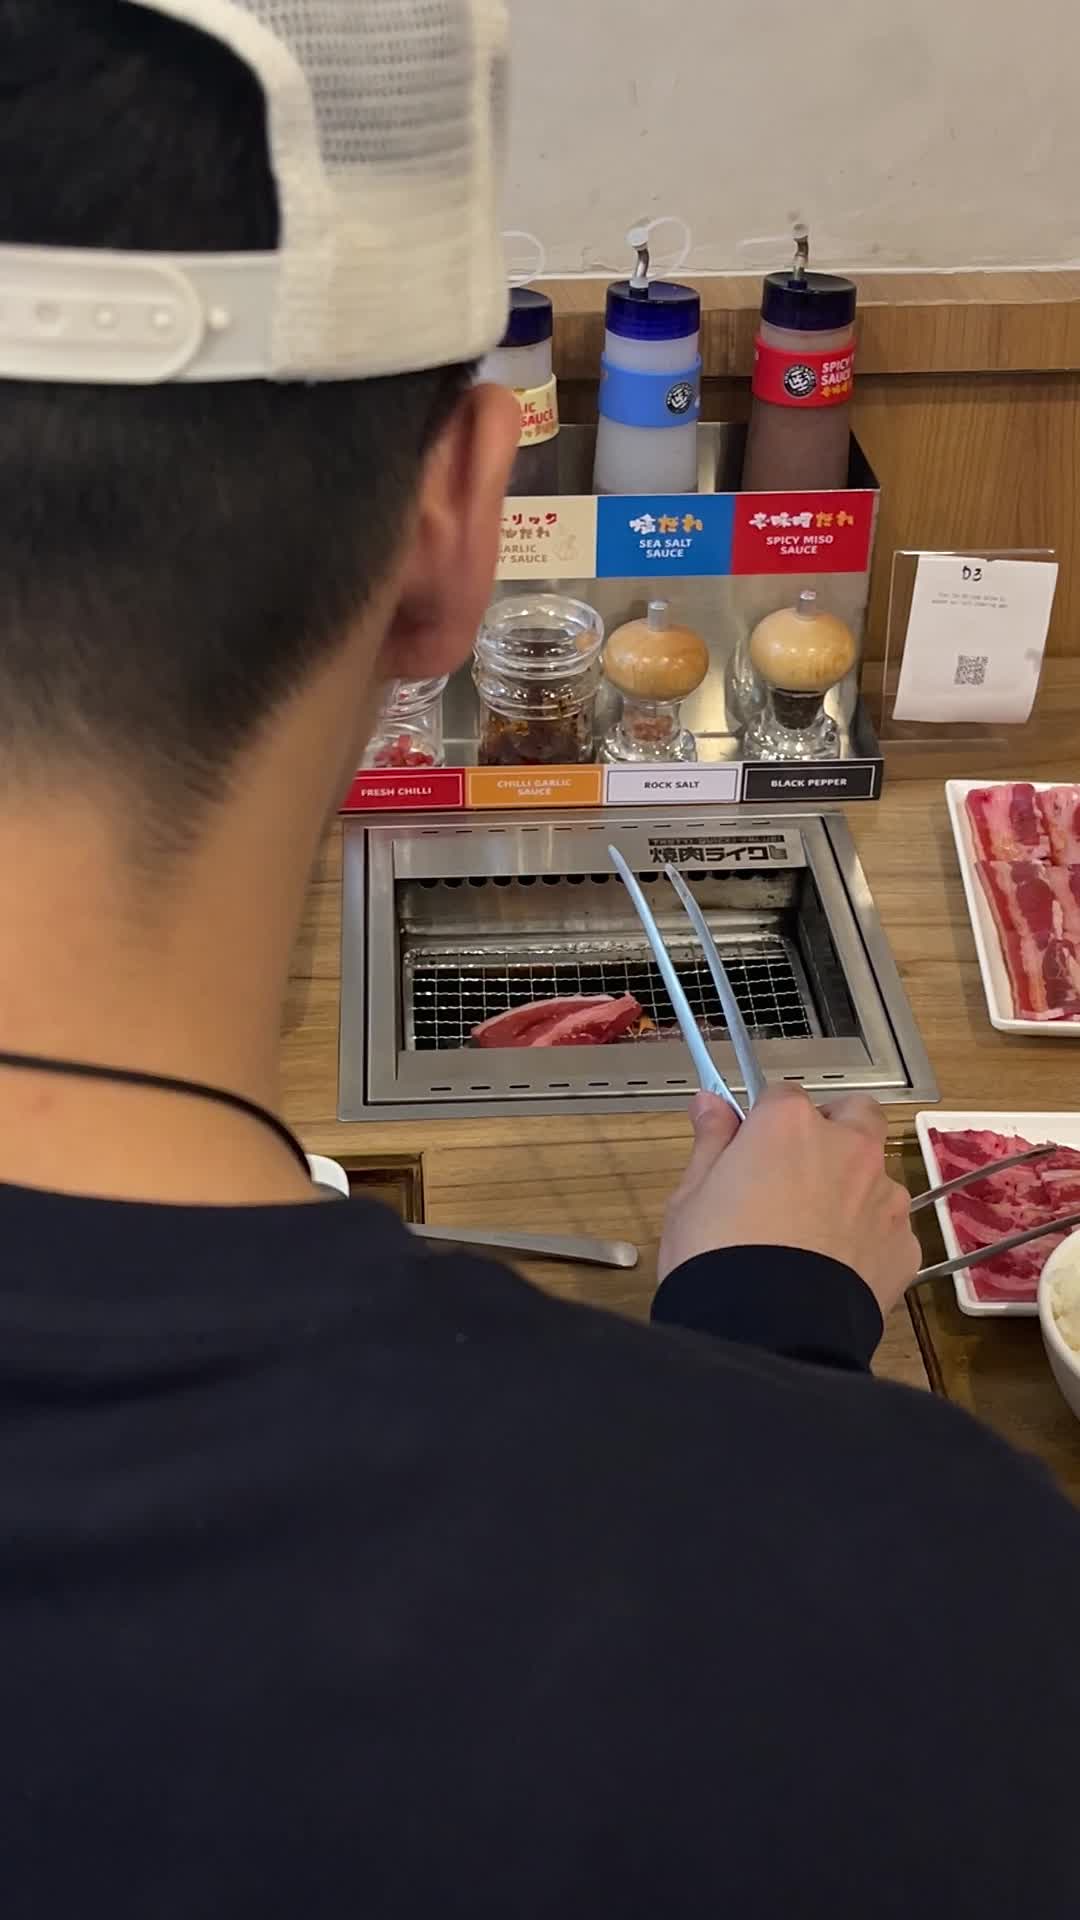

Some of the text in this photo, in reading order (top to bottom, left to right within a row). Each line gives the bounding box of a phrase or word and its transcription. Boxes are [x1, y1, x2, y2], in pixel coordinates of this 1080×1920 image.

[639, 538, 693, 549] SEA SALT
[765, 534, 834, 546] SPICY MISO
[645, 548, 685, 559] SAUCE
[779, 545, 819, 555] SAUCE
[510, 554, 548, 564] SAUCE
[961, 565, 982, 582] D3
[496, 778, 572, 789] CHILLI GARLIC
[643, 780, 700, 789] ROCK SALT
[770, 777, 848, 788] BLACK PEPPER
[360, 786, 432, 797] FRESH CHILLI
[517, 787, 552, 796] SAUCE
[649, 846, 769, 863] 焼肉ライク
